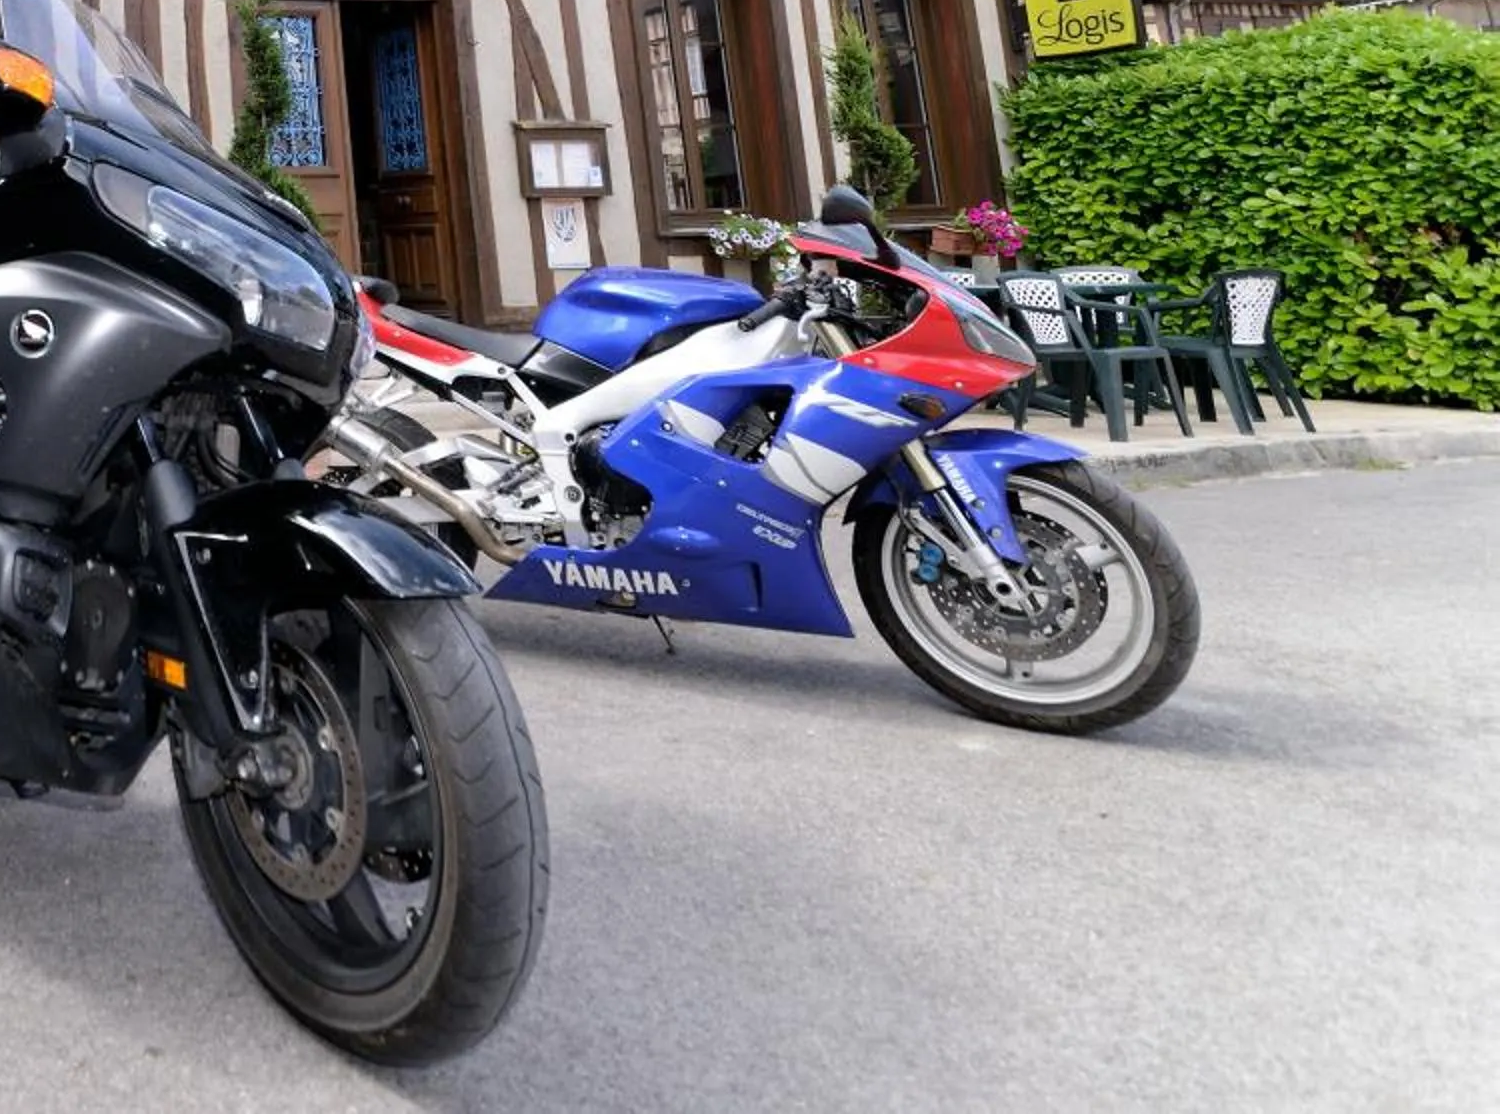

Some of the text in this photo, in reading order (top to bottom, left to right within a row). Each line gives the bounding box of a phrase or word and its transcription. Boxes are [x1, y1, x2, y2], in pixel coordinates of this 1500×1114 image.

[1036, 3, 1125, 46] Logis
[936, 452, 979, 505] YAMAHA
[542, 558, 679, 595] YAMAHA
